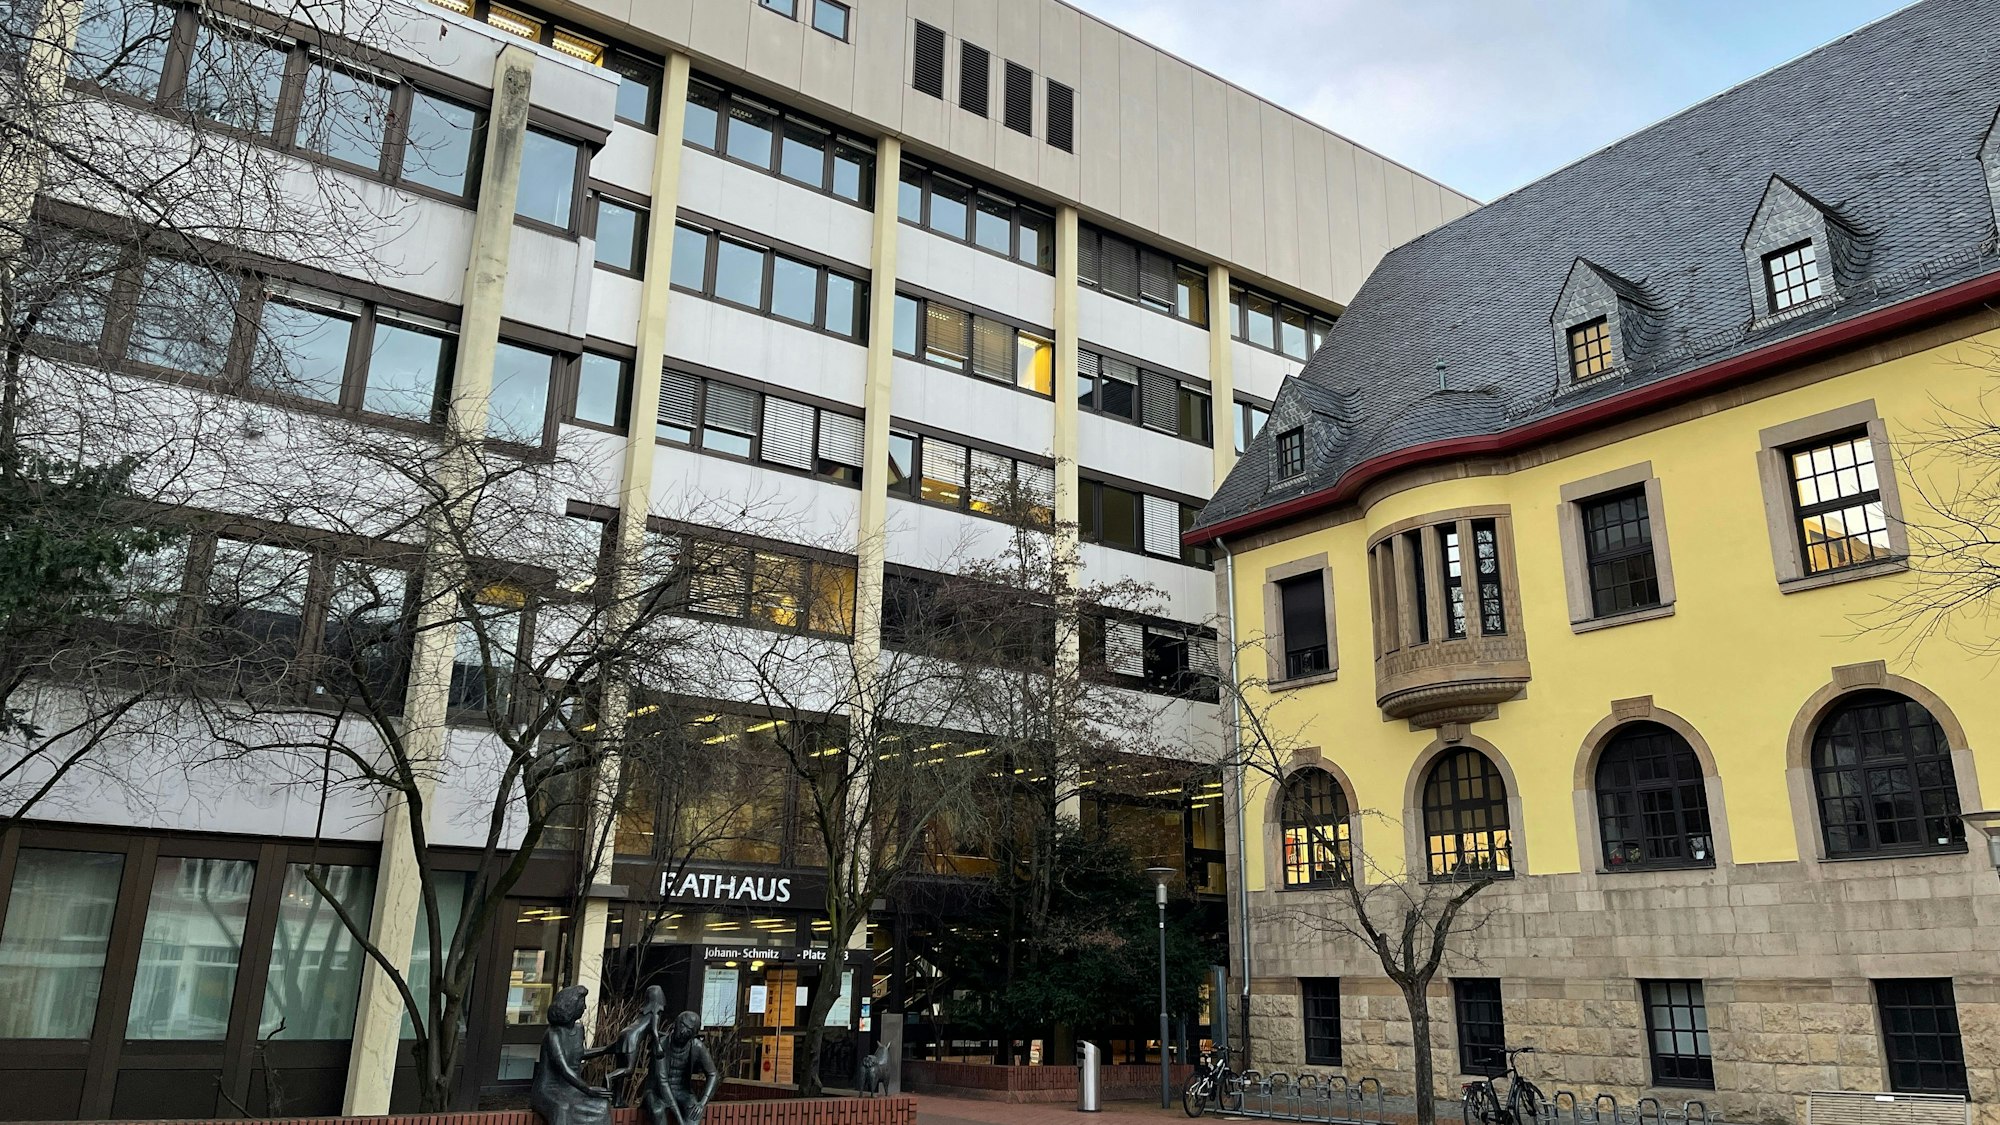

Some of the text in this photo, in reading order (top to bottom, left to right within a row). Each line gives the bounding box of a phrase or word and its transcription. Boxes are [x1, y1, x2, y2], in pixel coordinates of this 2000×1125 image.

[659, 871, 791, 903] RATHAUS
[742, 948, 780, 960] Schmitz
[802, 949, 827, 961] Platz
